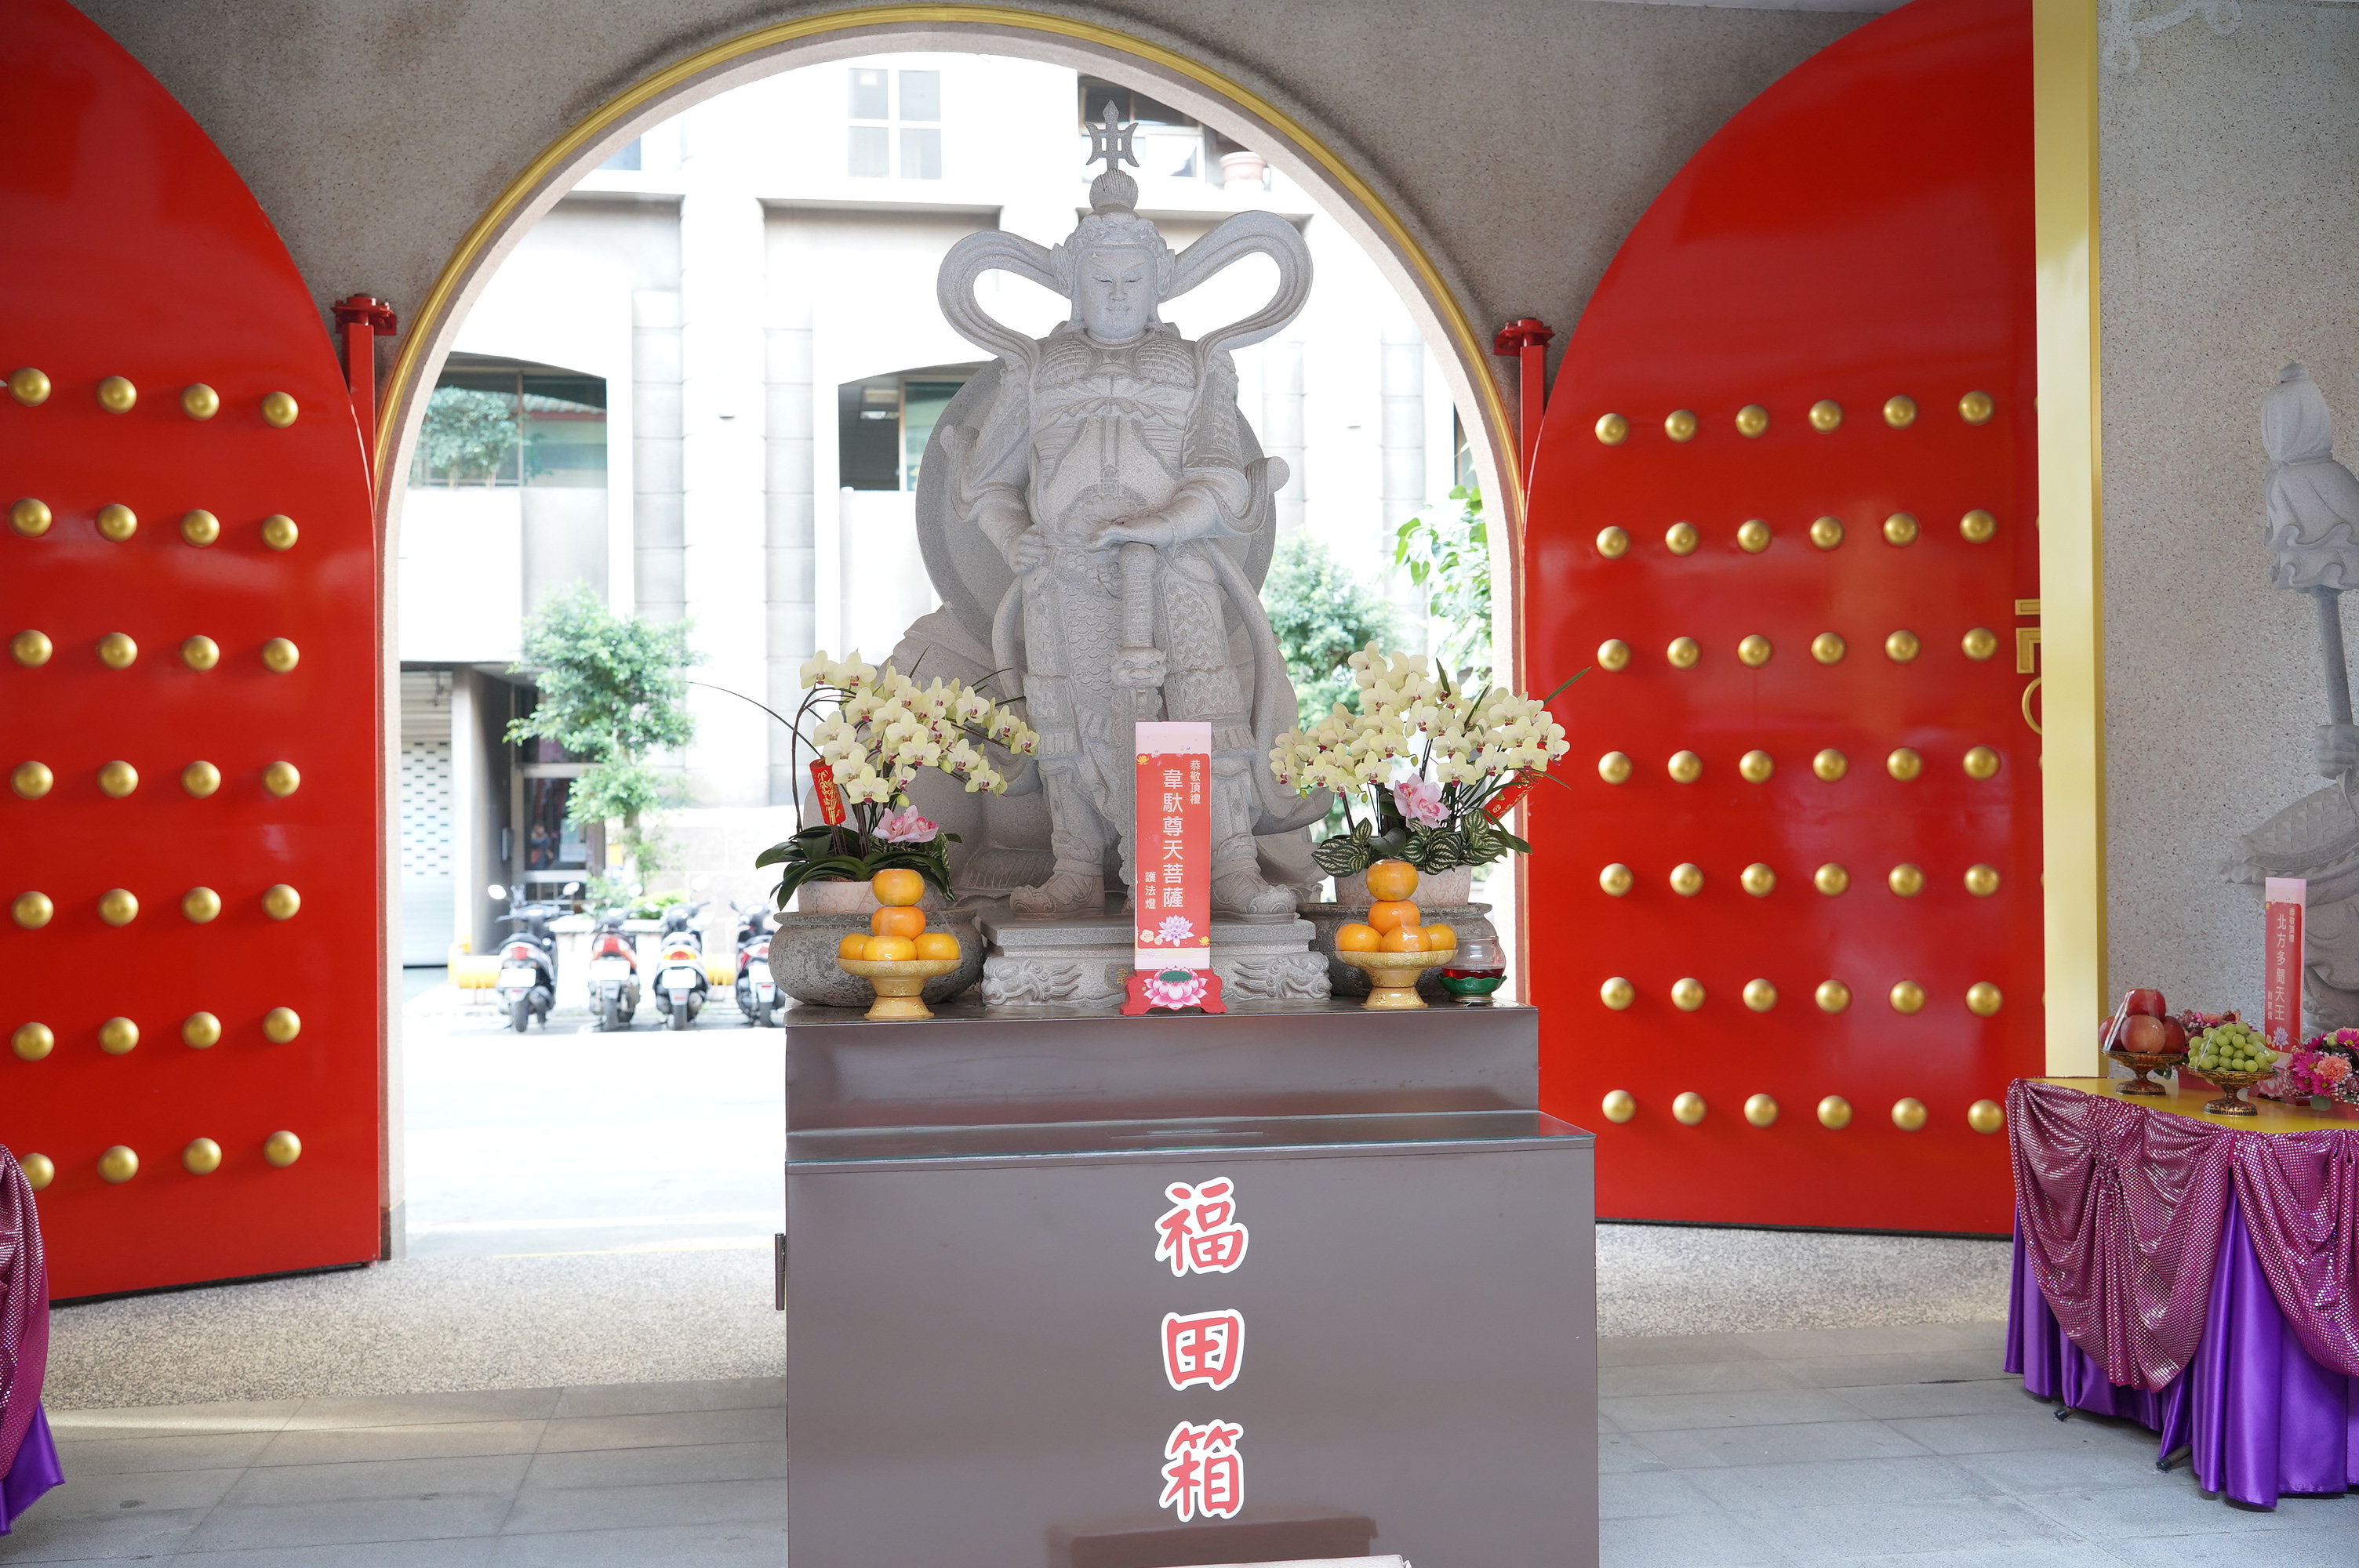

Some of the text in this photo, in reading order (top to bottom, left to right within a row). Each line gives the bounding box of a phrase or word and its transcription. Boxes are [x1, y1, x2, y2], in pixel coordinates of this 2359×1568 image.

[1190, 759, 1201, 804] 恭敬頂禮
[1145, 871, 1156, 909] 護法燈
[1162, 769, 1183, 908] 韋馱尊天菩薩
[2275, 913, 2287, 1021] 北方多聞天王
[1154, 1177, 1249, 1523] 福田箱
